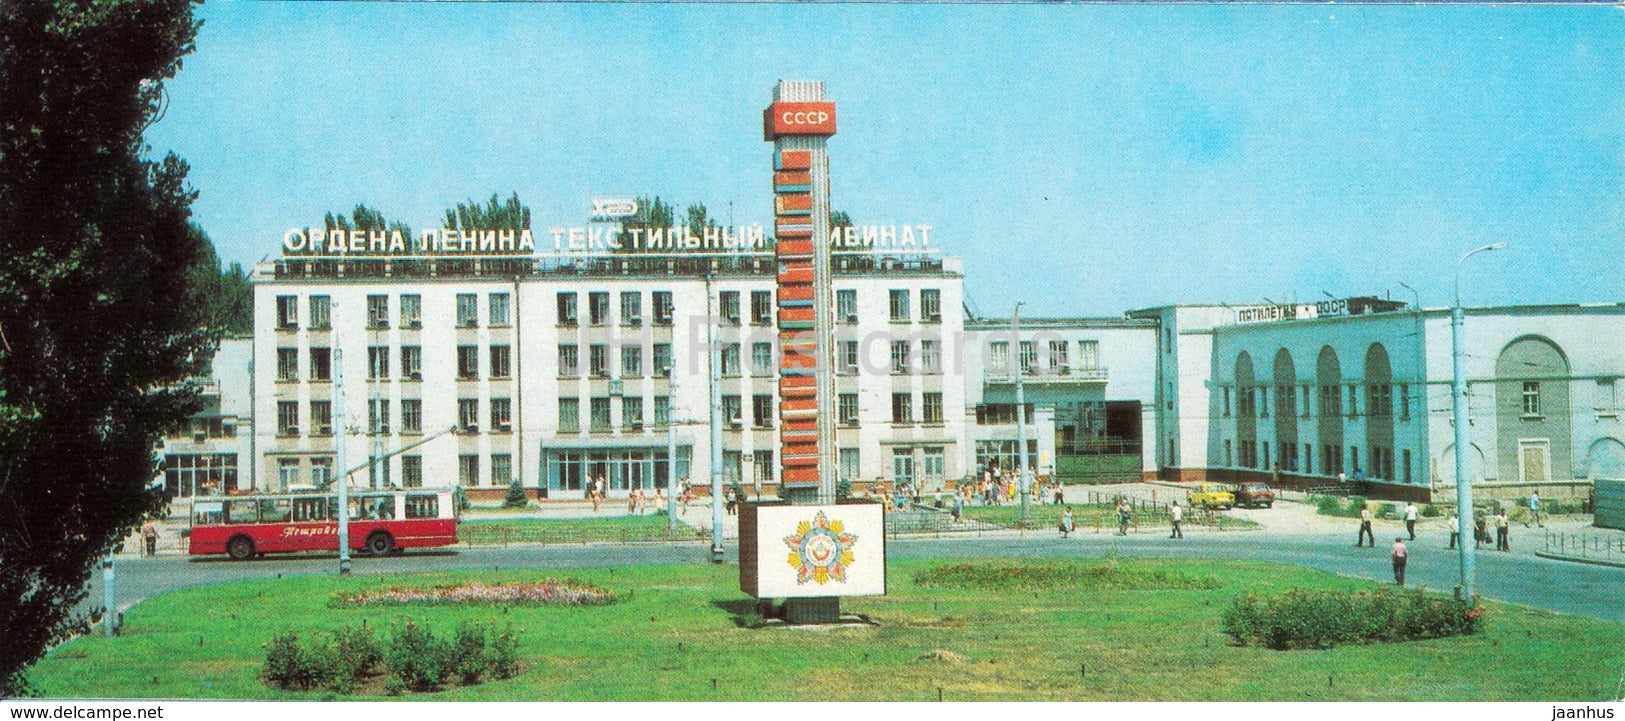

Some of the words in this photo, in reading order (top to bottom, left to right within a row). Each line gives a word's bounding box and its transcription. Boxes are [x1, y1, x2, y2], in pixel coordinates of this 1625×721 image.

[783, 111, 829, 125] СССР
[283, 228, 405, 253] ОРДЕНА
[420, 227, 535, 251] ЛЕНИНА
[550, 222, 764, 250] ТЕКСТИЛЬНЫЙ
[830, 224, 933, 247] МБИНАТ
